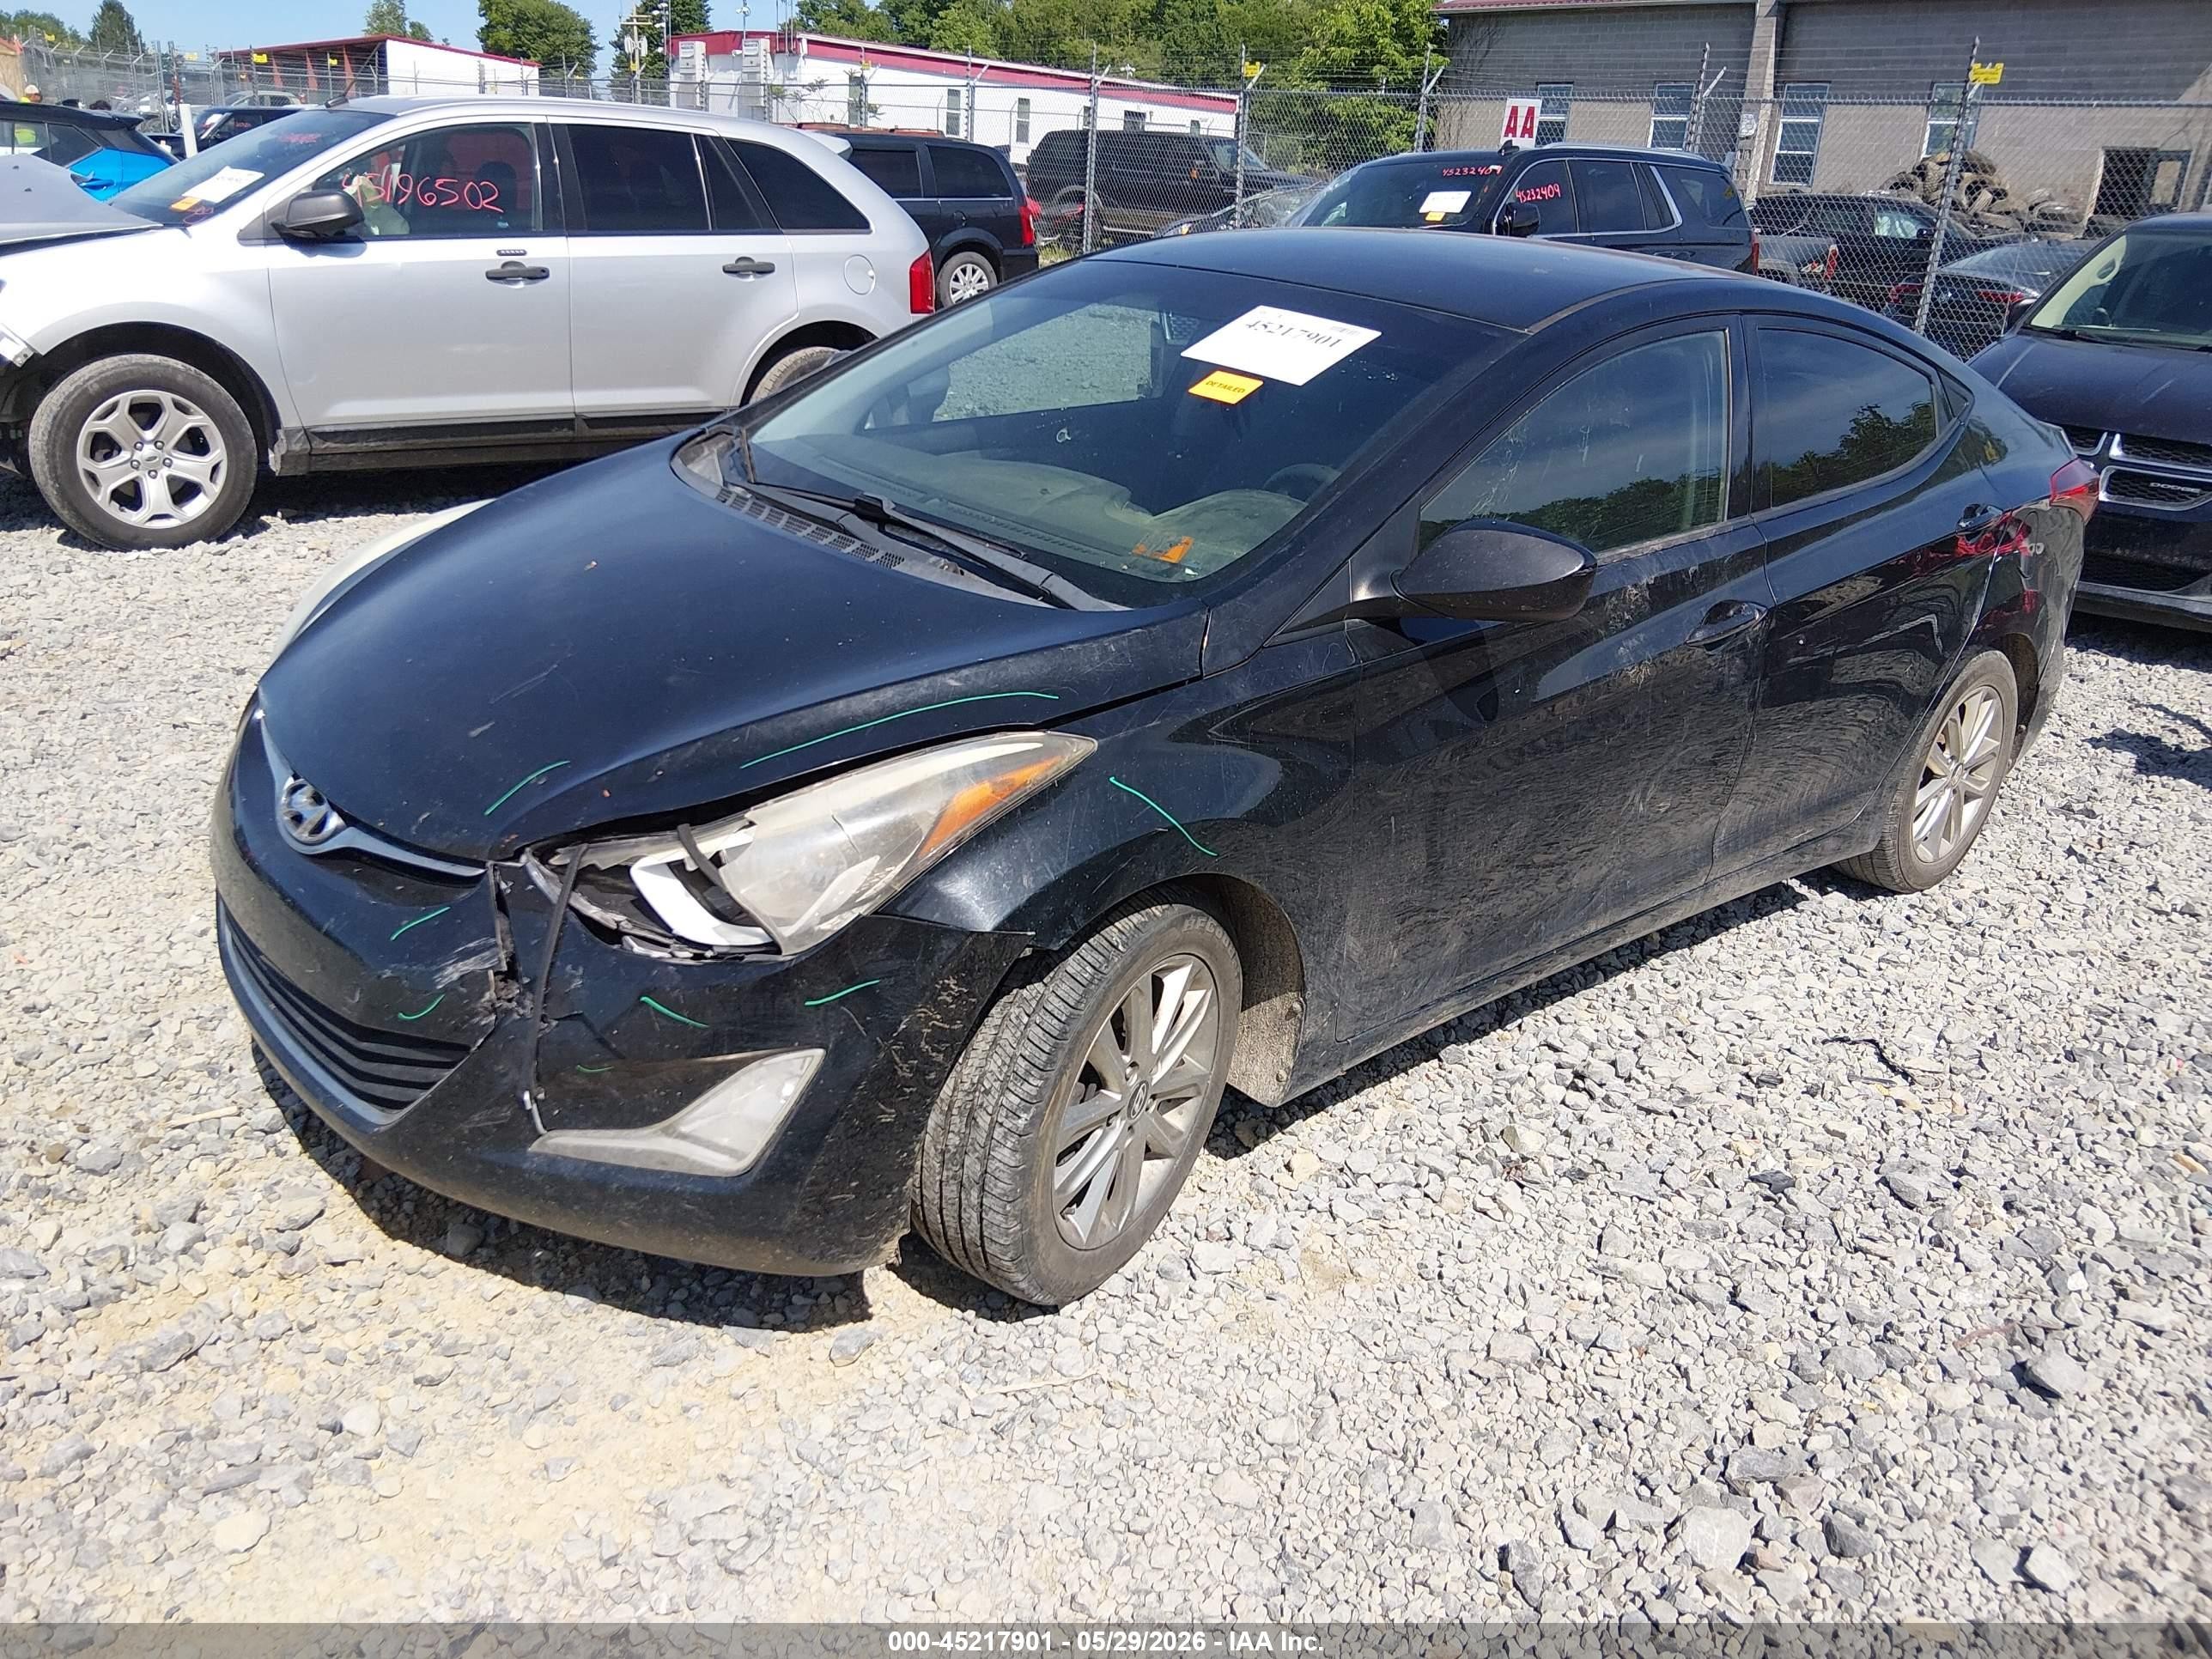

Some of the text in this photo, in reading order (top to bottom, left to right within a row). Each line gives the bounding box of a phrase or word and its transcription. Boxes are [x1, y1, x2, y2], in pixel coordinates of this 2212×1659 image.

[1504, 105, 1535, 138] AA
[1443, 165, 1502, 176] 45232409
[341, 173, 505, 214] 45196502
[1515, 182, 1561, 204] 45232409
[1246, 320, 1342, 347] 45217901
[1206, 380, 1246, 394] DETAILED
